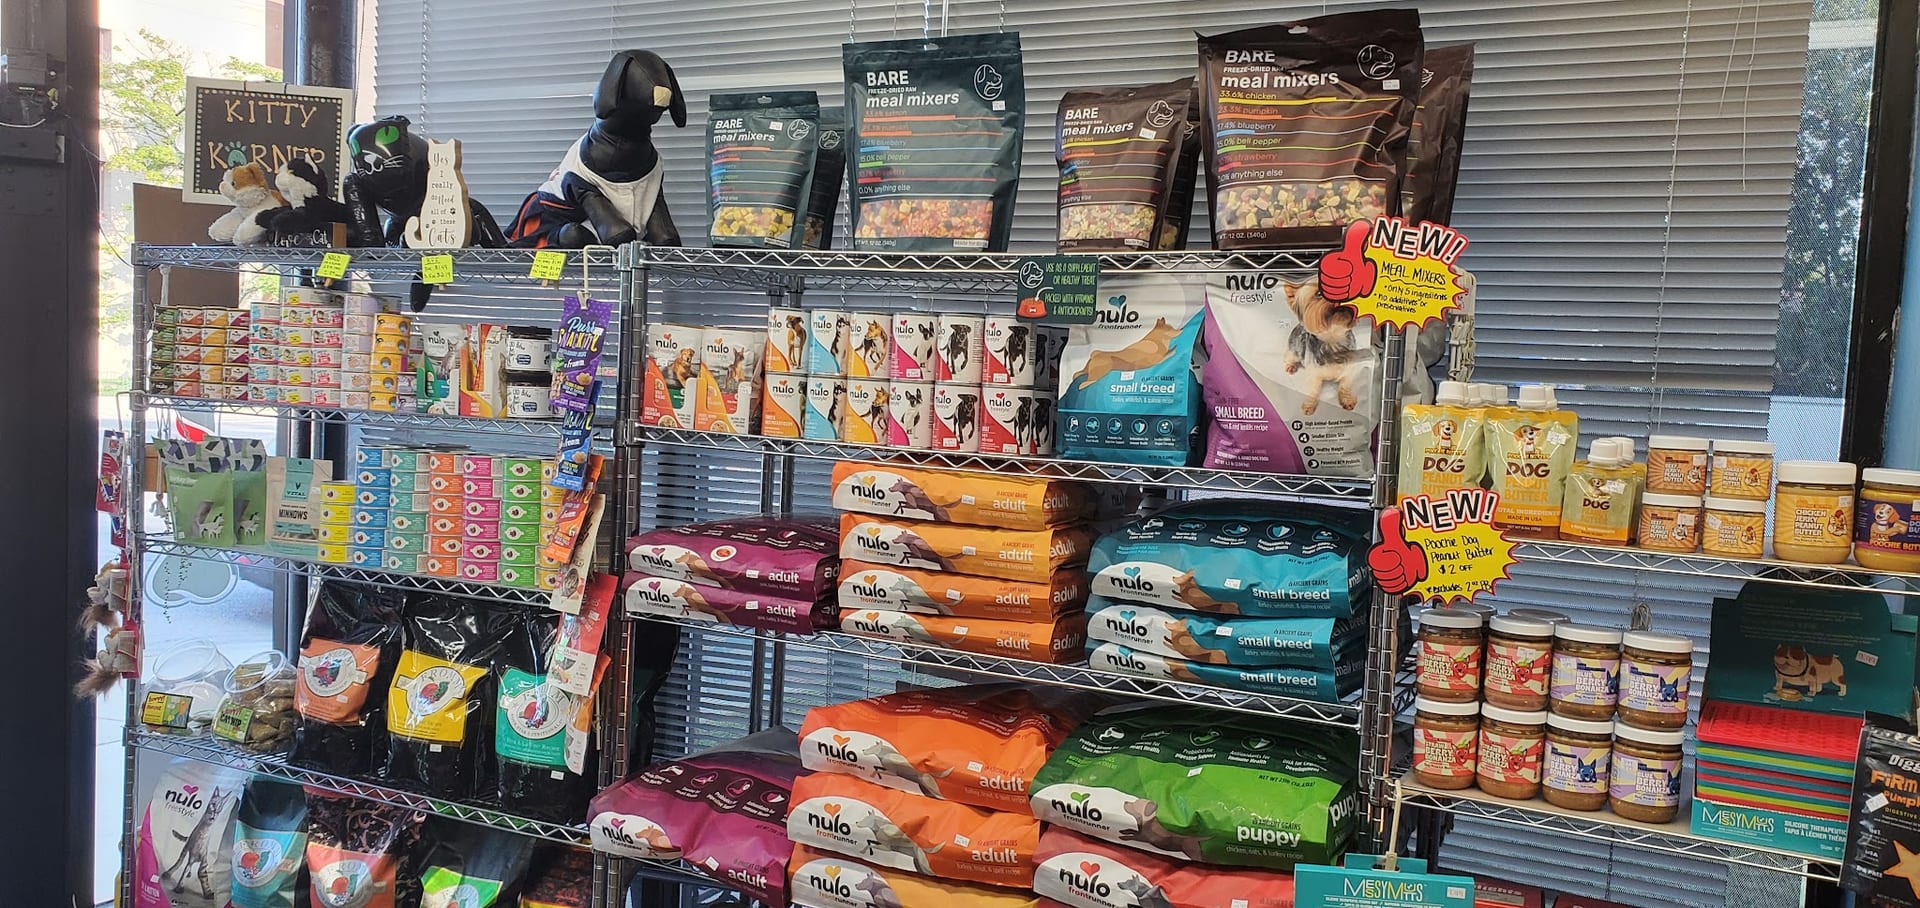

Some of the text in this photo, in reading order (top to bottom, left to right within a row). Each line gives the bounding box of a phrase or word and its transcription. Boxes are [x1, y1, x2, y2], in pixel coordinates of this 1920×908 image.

[1225, 50, 1276, 63] BARE
[866, 70, 909, 86] BARE
[1221, 72, 1340, 88] meal mixers
[866, 91, 960, 108] meal mixers
[1245, 92, 1277, 100] chicken
[224, 99, 317, 128] KITTY
[1065, 107, 1099, 120] BARE
[1243, 107, 1279, 116] pumpkin
[715, 118, 743, 129] BARE
[1062, 121, 1134, 137] meal mixers
[1237, 122, 1276, 131] blueberry
[713, 131, 775, 144] meal mixers
[1236, 136, 1282, 147] bell pepper
[433, 152, 449, 167] Yes
[1230, 168, 1284, 180] anything else
[431, 181, 453, 190] really
[428, 228, 455, 247] Cats
[1372, 217, 1465, 263] NEW!
[1068, 263, 1096, 273] SUPPLEMENT
[1381, 262, 1446, 286] MEAL MIXERS
[1061, 275, 1081, 285] HEALTHY
[1081, 275, 1096, 285] TREAT
[1230, 291, 1273, 304] freestyle
[1388, 284, 1404, 296] only
[1411, 288, 1448, 301] ingredients
[1389, 295, 1418, 306] additives
[1376, 302, 1417, 314] preservatives
[567, 316, 596, 336] Purr
[1110, 382, 1175, 394] small breed
[1215, 406, 1264, 419] SMALL BREED
[1423, 456, 1466, 473] DOG
[1506, 463, 1550, 478] DOG
[1423, 474, 1464, 484] PEANUT
[851, 482, 885, 500] nulo
[1505, 490, 1548, 501] BUTTER
[993, 499, 1027, 512] adult
[1044, 494, 1070, 509] adult
[1583, 498, 1610, 510] DOG
[279, 509, 308, 520] MINNOWS
[1403, 490, 1497, 532] NEW!
[857, 533, 889, 551] nulo
[1050, 539, 1076, 557] adult
[1425, 535, 1479, 550] Poochie Dog
[1870, 541, 1901, 549] POOCHIE
[641, 553, 673, 568] nulo
[999, 549, 1033, 562] adult
[1430, 546, 1494, 563] Peanut Butter
[1450, 564, 1456, 575] 2
[768, 570, 800, 584] adult
[1110, 574, 1154, 592] nulo
[638, 588, 670, 604] nulo
[852, 582, 887, 598] nulo
[1053, 584, 1078, 603] adult
[1120, 588, 1161, 599] frontrunner
[1252, 587, 1330, 600] small breed
[996, 592, 1030, 606] adult
[766, 604, 796, 617] adult
[854, 618, 890, 634] nulo
[1106, 618, 1148, 636] nulo
[996, 637, 1030, 650] adult
[1053, 632, 1080, 650] adult
[1115, 631, 1153, 644] frontrunner
[1238, 636, 1312, 649] small breed
[1106, 653, 1146, 670] nulo
[1424, 660, 1451, 668] BERRY
[1489, 662, 1513, 672] BERRY
[1424, 667, 1454, 676] BONANZA
[1240, 672, 1317, 686] small breed
[1576, 677, 1607, 687] BERRY
[1576, 684, 1609, 693] BONANZA
[1629, 682, 1660, 693] BERRY
[1629, 689, 1663, 700] BONANZA
[817, 741, 857, 762] nulo
[1425, 748, 1454, 757] BERRY
[1482, 750, 1507, 760] BERRY
[826, 758, 866, 771] frontrunner
[1425, 755, 1456, 763] BONANZA
[1550, 761, 1577, 772] BERRY
[1550, 768, 1580, 779] BONANZA
[980, 775, 1024, 792] adult
[1637, 778, 1668, 787] BERRY
[1636, 785, 1670, 794] BONANZA
[165, 789, 203, 810] nulo
[164, 802, 196, 818] freestyle
[1051, 798, 1102, 822] nulo
[1884, 807, 1917, 820] DIGESTIVE
[808, 812, 851, 836] nulo
[1063, 813, 1111, 832] frontrunner
[1784, 820, 1809, 830] SILICONE
[601, 824, 633, 845] nulo
[816, 830, 857, 846] frontrunner
[1236, 824, 1300, 848] puppy
[971, 848, 1018, 864] adult
[728, 868, 768, 889] adult
[1059, 868, 1110, 898] nulo
[810, 874, 850, 898] nulo
[1068, 886, 1116, 908] frontrunner
